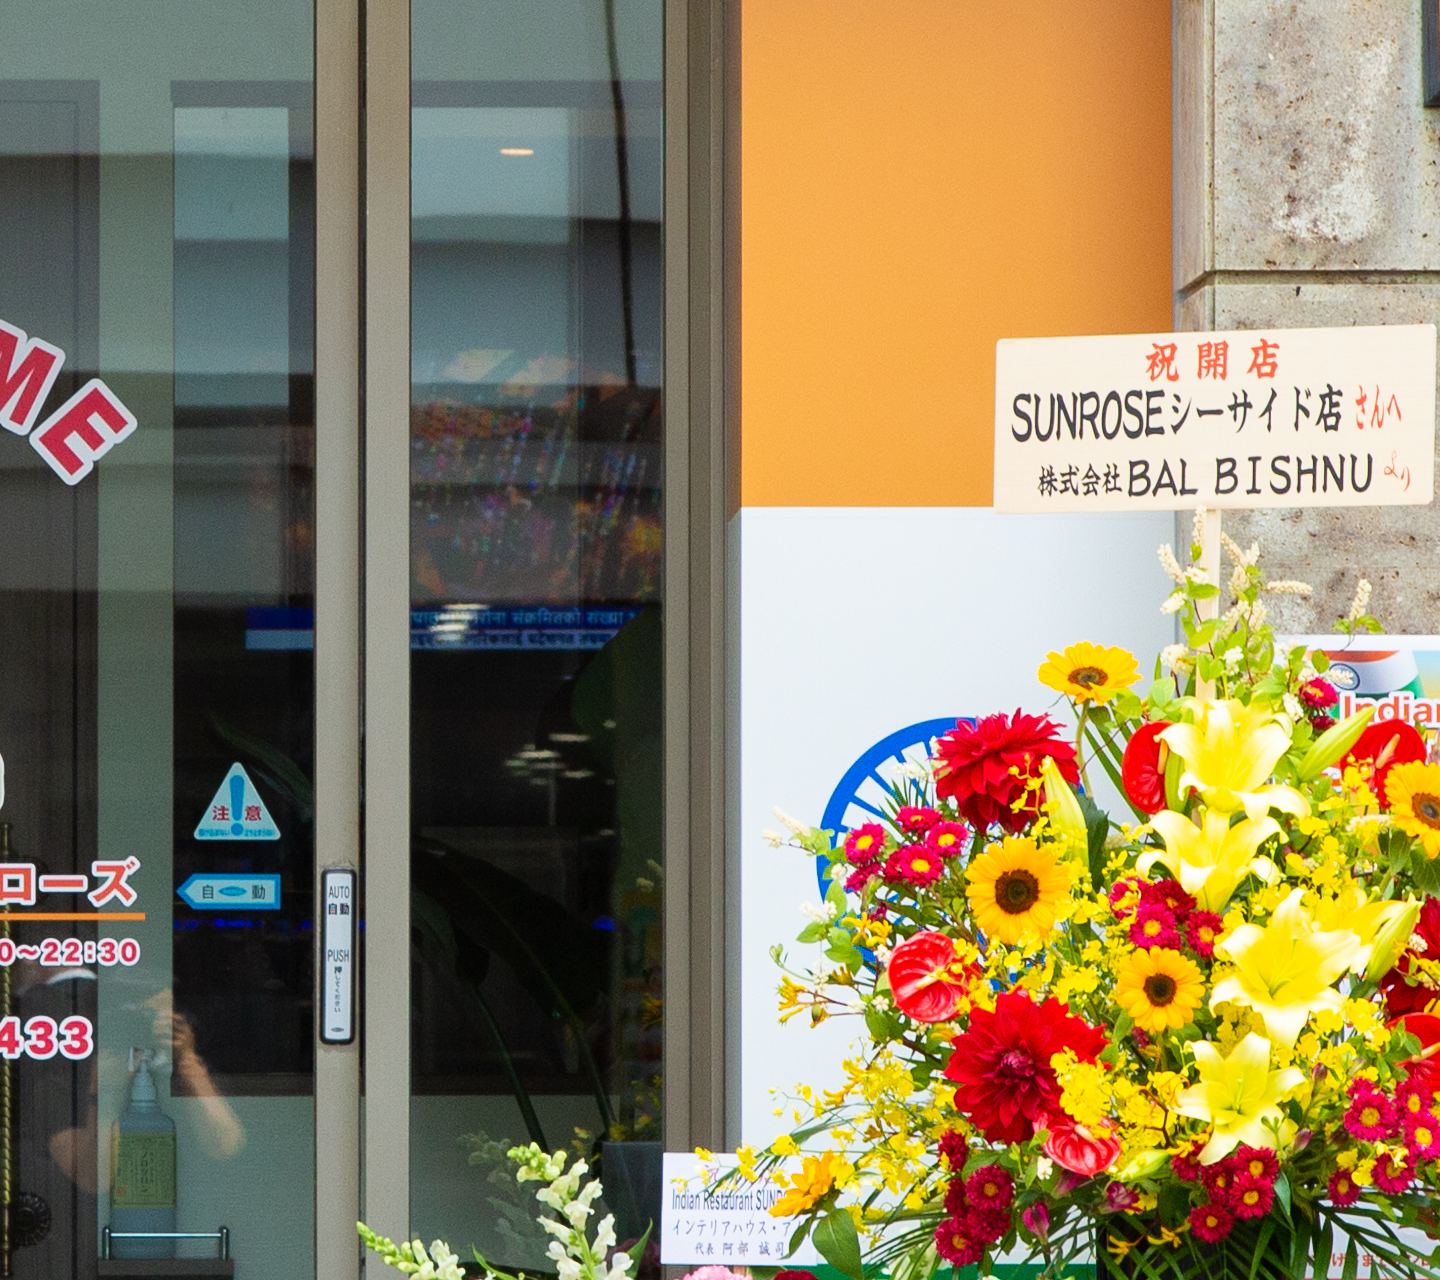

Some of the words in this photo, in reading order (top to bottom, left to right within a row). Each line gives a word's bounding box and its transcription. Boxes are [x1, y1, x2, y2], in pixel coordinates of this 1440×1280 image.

[1145, 337, 1281, 382] 祝開店
[1011, 383, 1343, 443] SUNROSEシーサイド店
[1354, 385, 1403, 431] さんへ
[1214, 453, 1373, 495] BISHNU
[328, 885, 351, 899] AUTO
[327, 949, 350, 963] PUSH
[671, 1188, 701, 1211] Indian
[703, 1188, 754, 1211] Restaurant
[672, 1218, 802, 1237] インテリアハウス・ア
